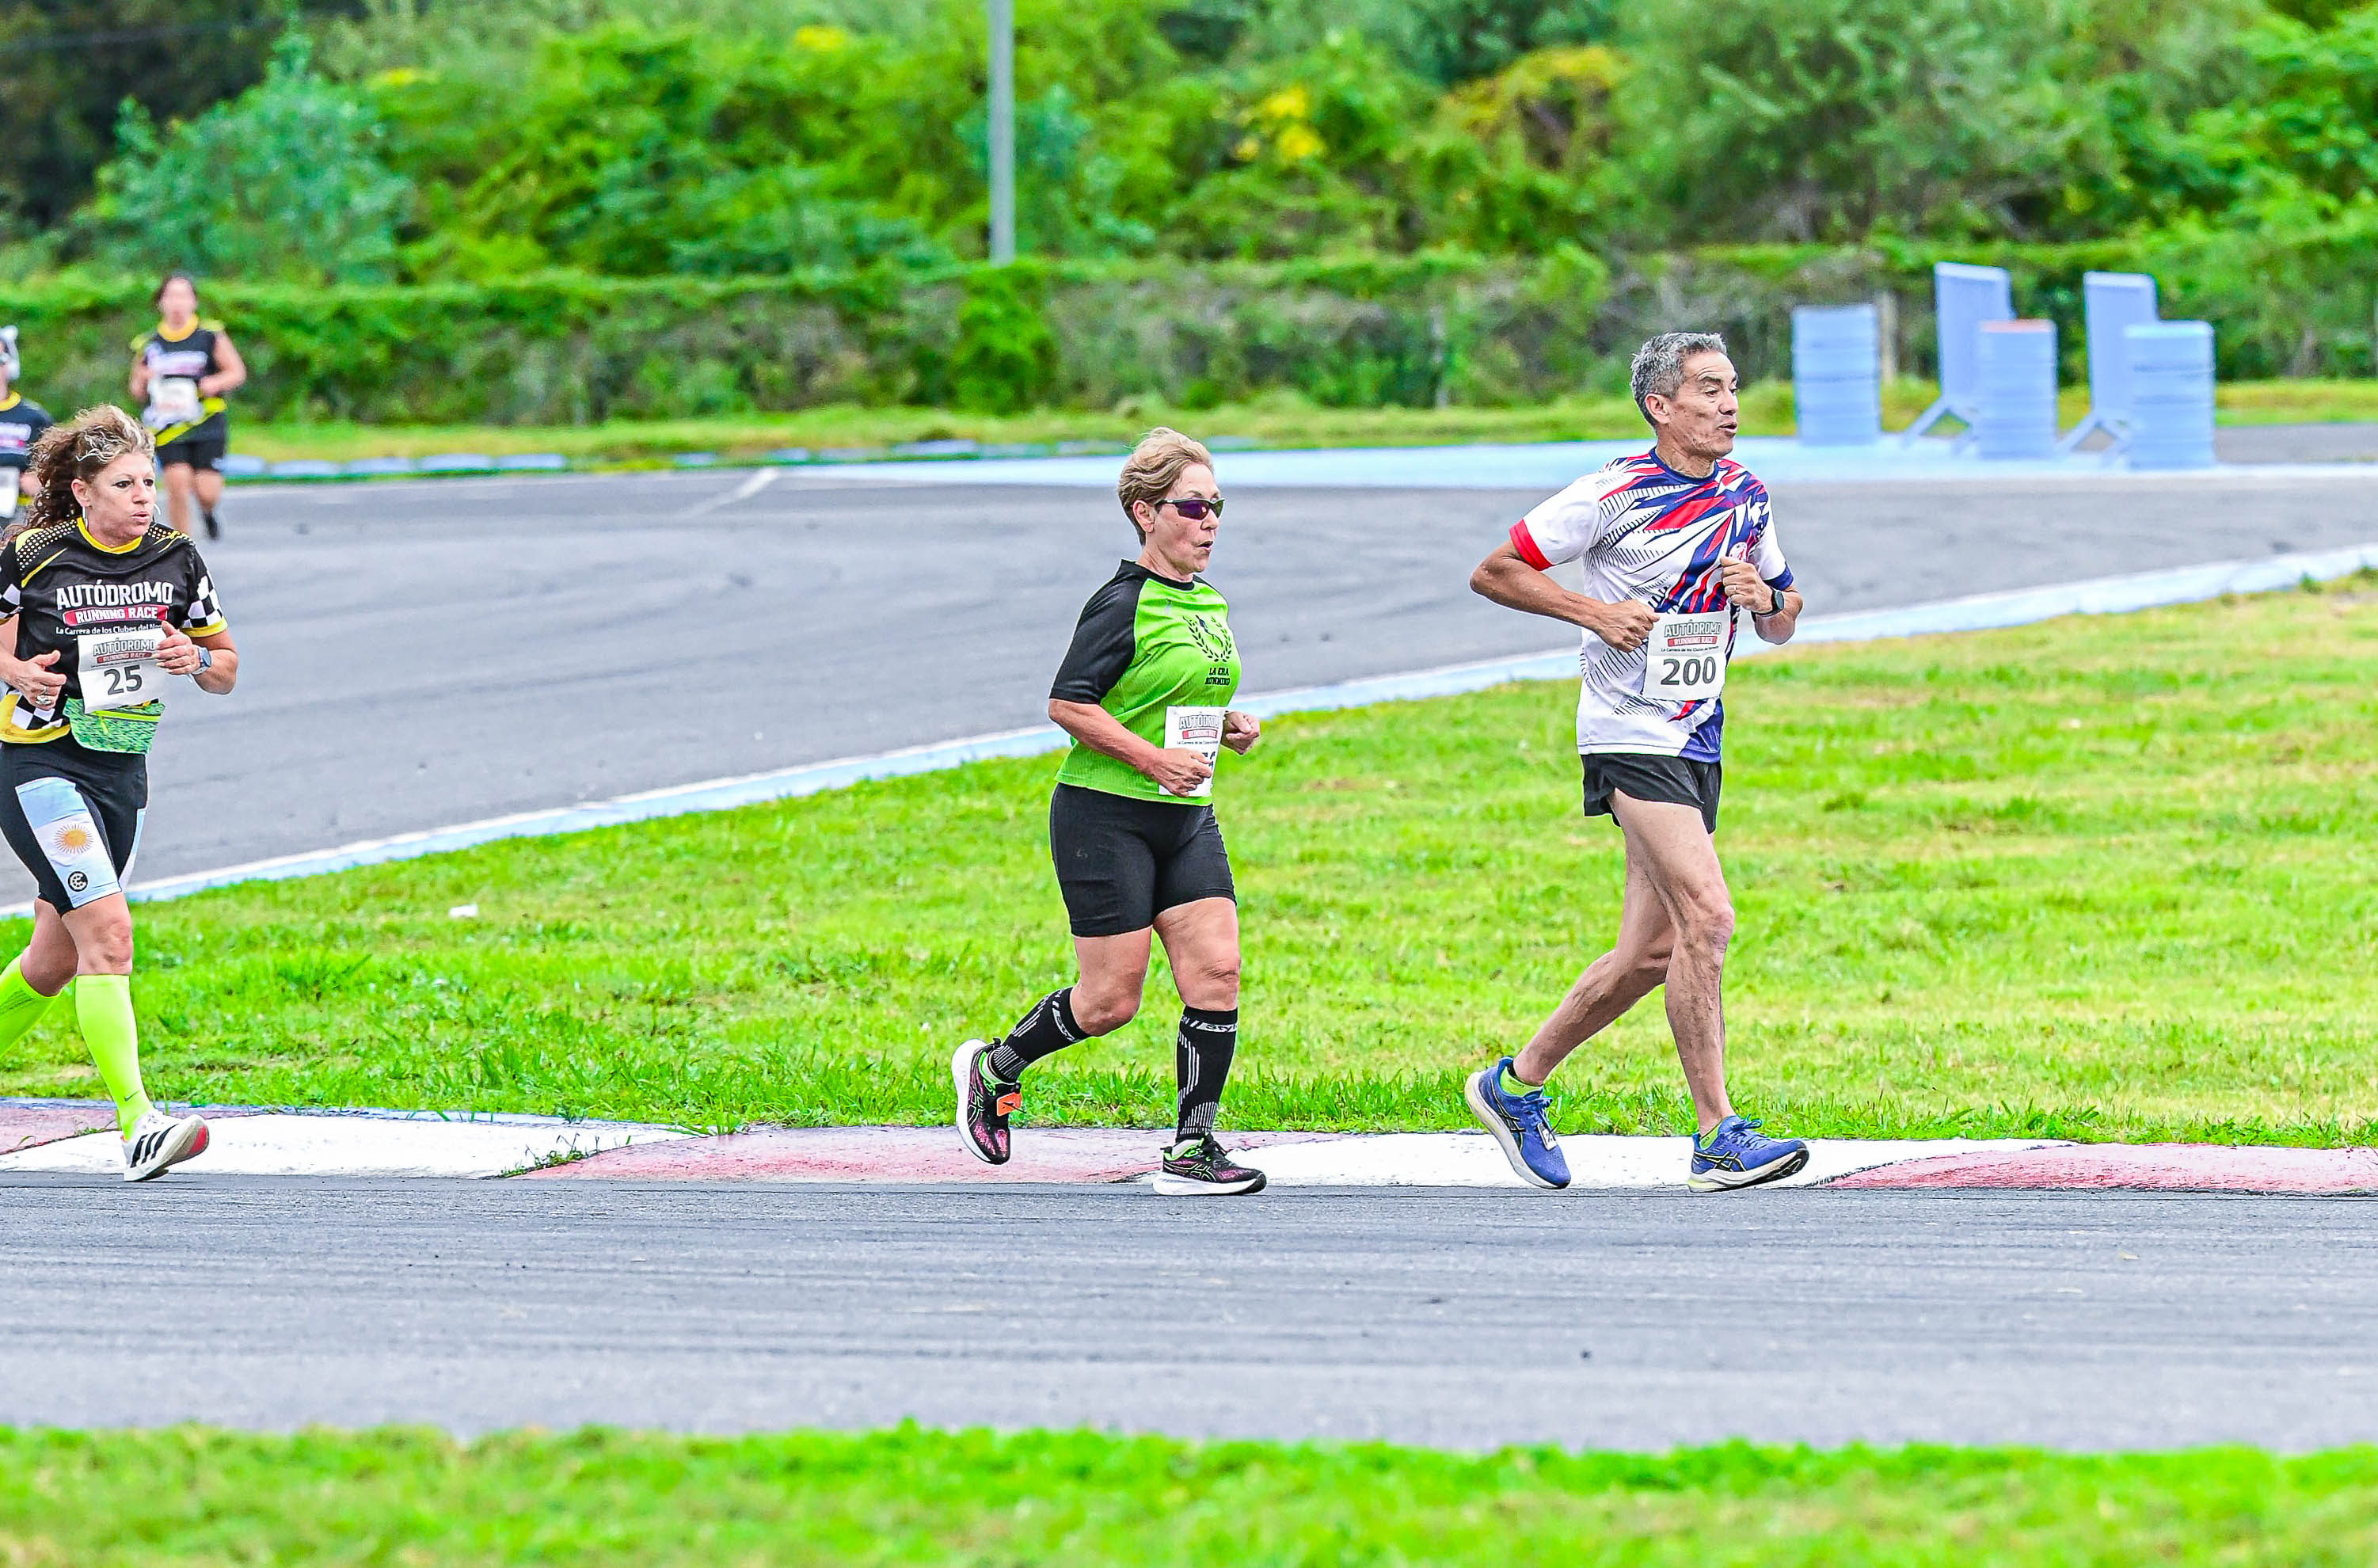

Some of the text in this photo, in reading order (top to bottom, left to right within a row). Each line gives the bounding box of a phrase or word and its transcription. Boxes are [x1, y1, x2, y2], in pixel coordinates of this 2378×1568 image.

[56, 579, 174, 611] AUTÓDROMO
[75, 606, 158, 624] RUNNING RACE
[1664, 618, 1722, 637] AUTÓDROMO
[93, 637, 156, 657] AUTÓDROMO
[104, 664, 143, 695] 25
[1660, 657, 1716, 686] 200
